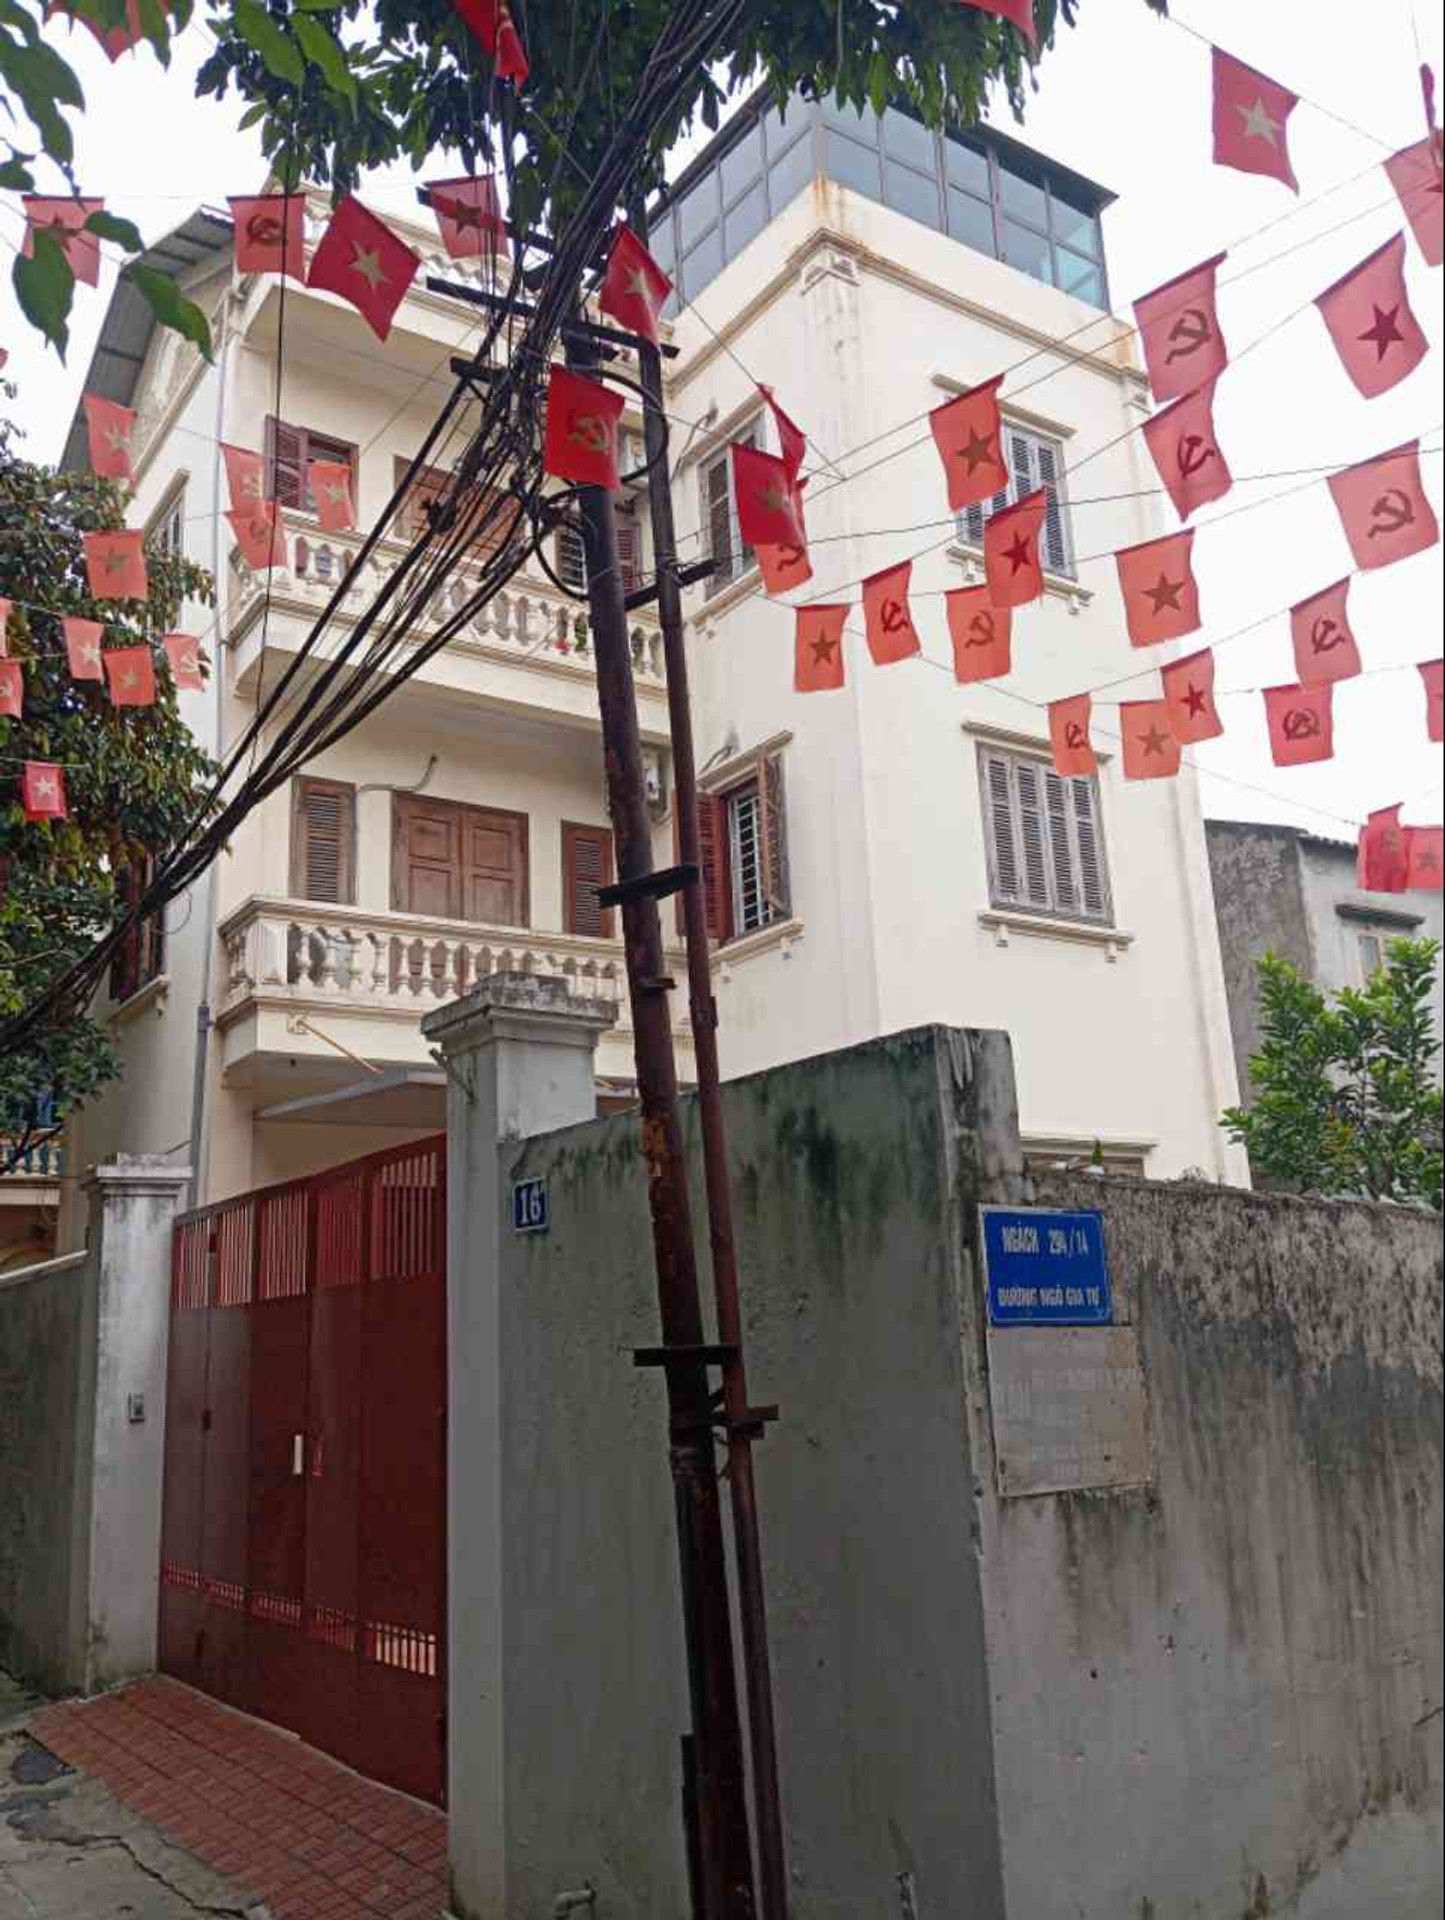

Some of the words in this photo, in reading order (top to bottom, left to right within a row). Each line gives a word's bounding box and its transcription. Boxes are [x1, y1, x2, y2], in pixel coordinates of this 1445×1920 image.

[520, 1182, 542, 1223] 16
[1002, 1221, 1040, 1254] NGÁCH
[1040, 1284, 1064, 1307] NGÔ
[1065, 1287, 1085, 1306] GIA
